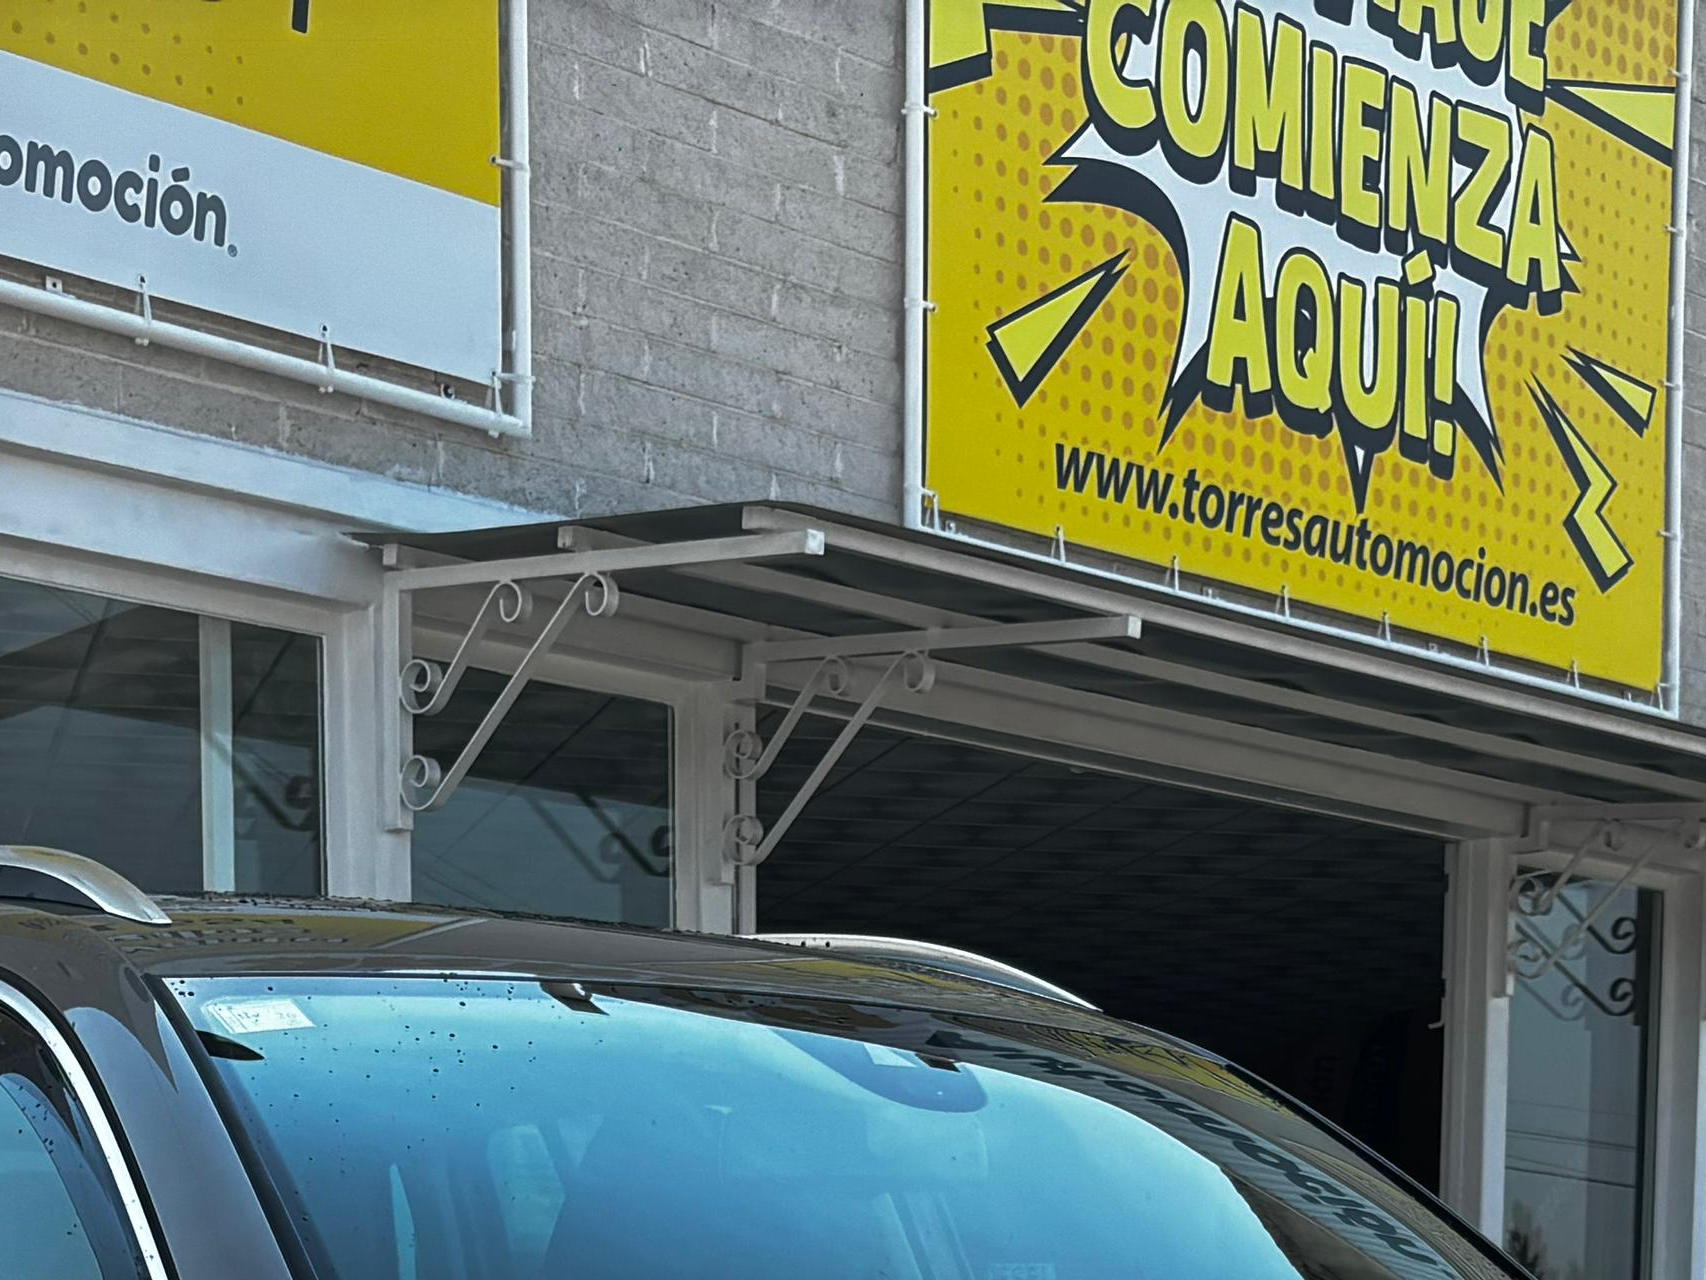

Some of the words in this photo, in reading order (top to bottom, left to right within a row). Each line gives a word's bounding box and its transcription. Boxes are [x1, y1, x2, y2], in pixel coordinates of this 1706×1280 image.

[1084, 0, 1563, 308] COMIENZA
[1201, 211, 1460, 472] AQUÍ!
[1053, 443, 1578, 628] www.torresautomocion.es
